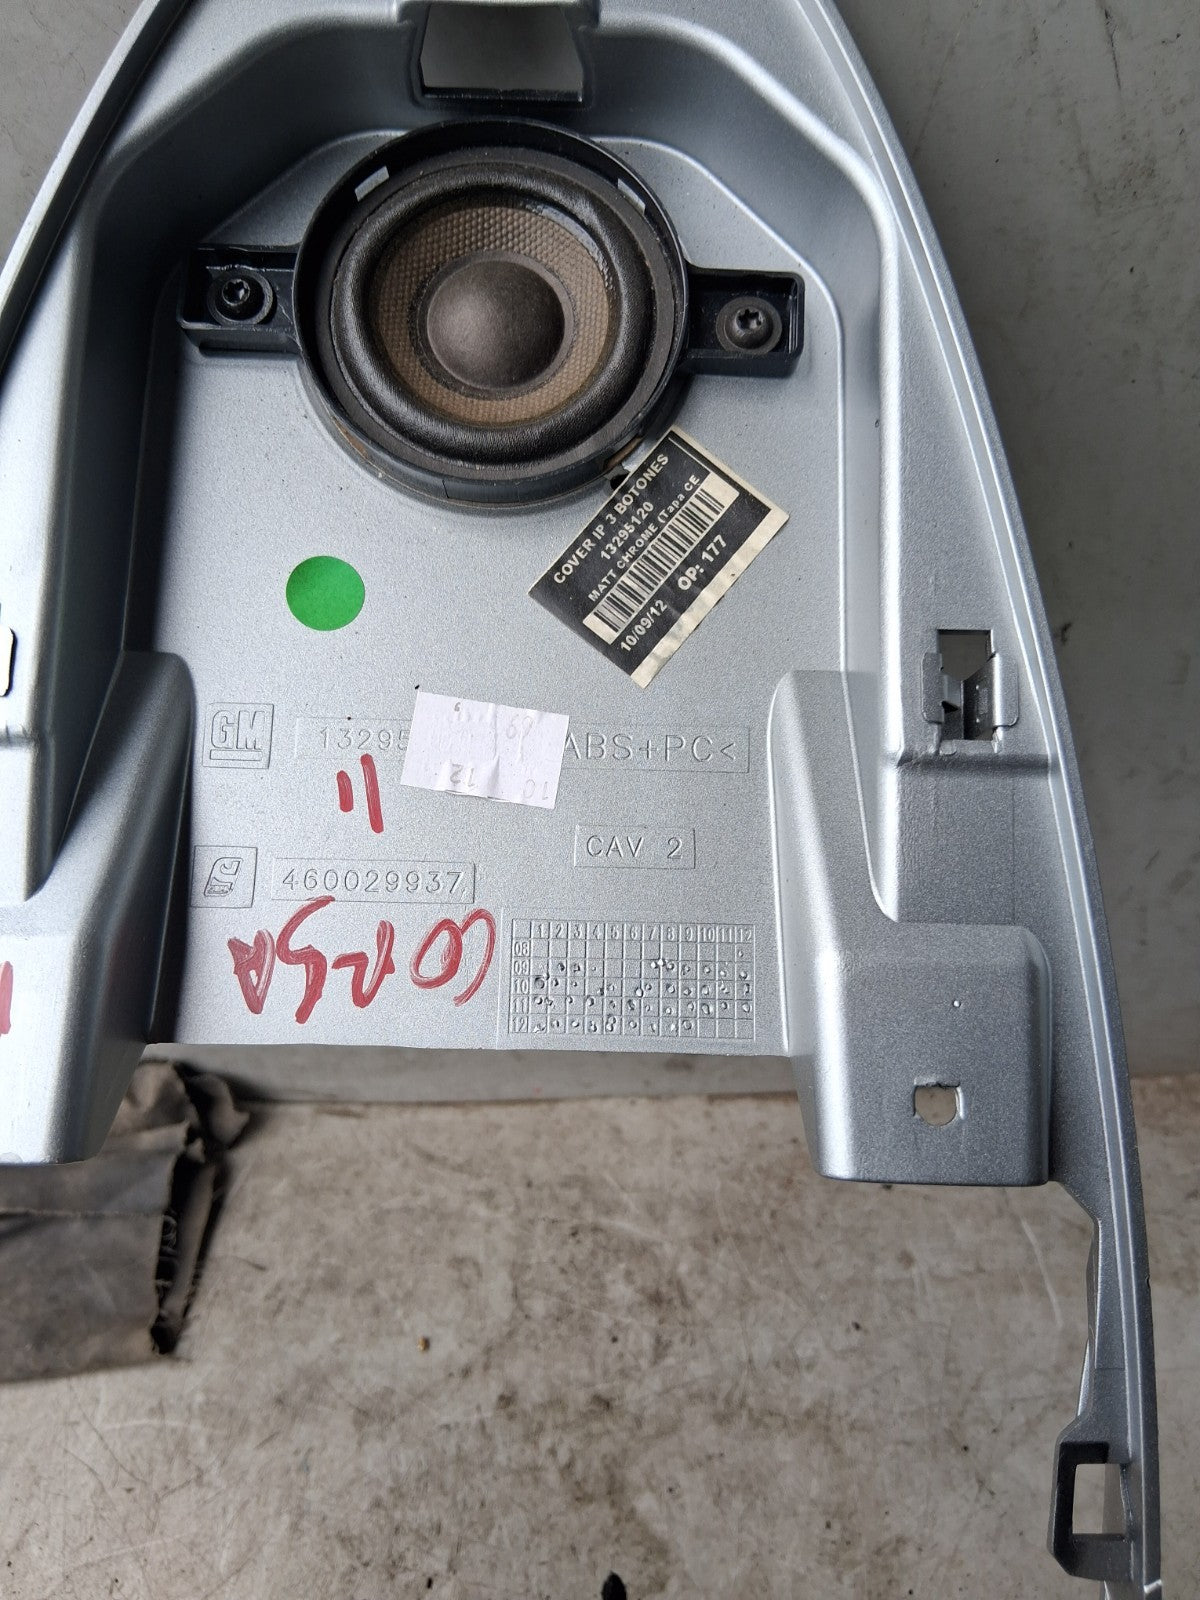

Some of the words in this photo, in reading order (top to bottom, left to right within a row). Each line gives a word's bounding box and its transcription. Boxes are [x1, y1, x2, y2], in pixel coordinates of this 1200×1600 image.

[554, 539, 596, 584] COVER
[592, 525, 605, 541] IP
[606, 513, 616, 525] 3
[615, 453, 669, 513] BOTONES
[587, 572, 617, 602] MATT
[616, 523, 658, 569] CHROME
[657, 493, 685, 525] (Tapa
[684, 474, 700, 492] CE
[600, 501, 654, 561] 13295120
[620, 599, 668, 652] 10/09/12
[677, 564, 705, 591] OP:
[701, 534, 727, 563] 177
[210, 710, 265, 750] GM
[586, 834, 645, 859] CAV
[667, 836, 683, 860] 2
[282, 868, 463, 894] 460029937
[699, 927, 715, 941] 10
[719, 928, 733, 942] 11
[737, 928, 752, 942] 12
